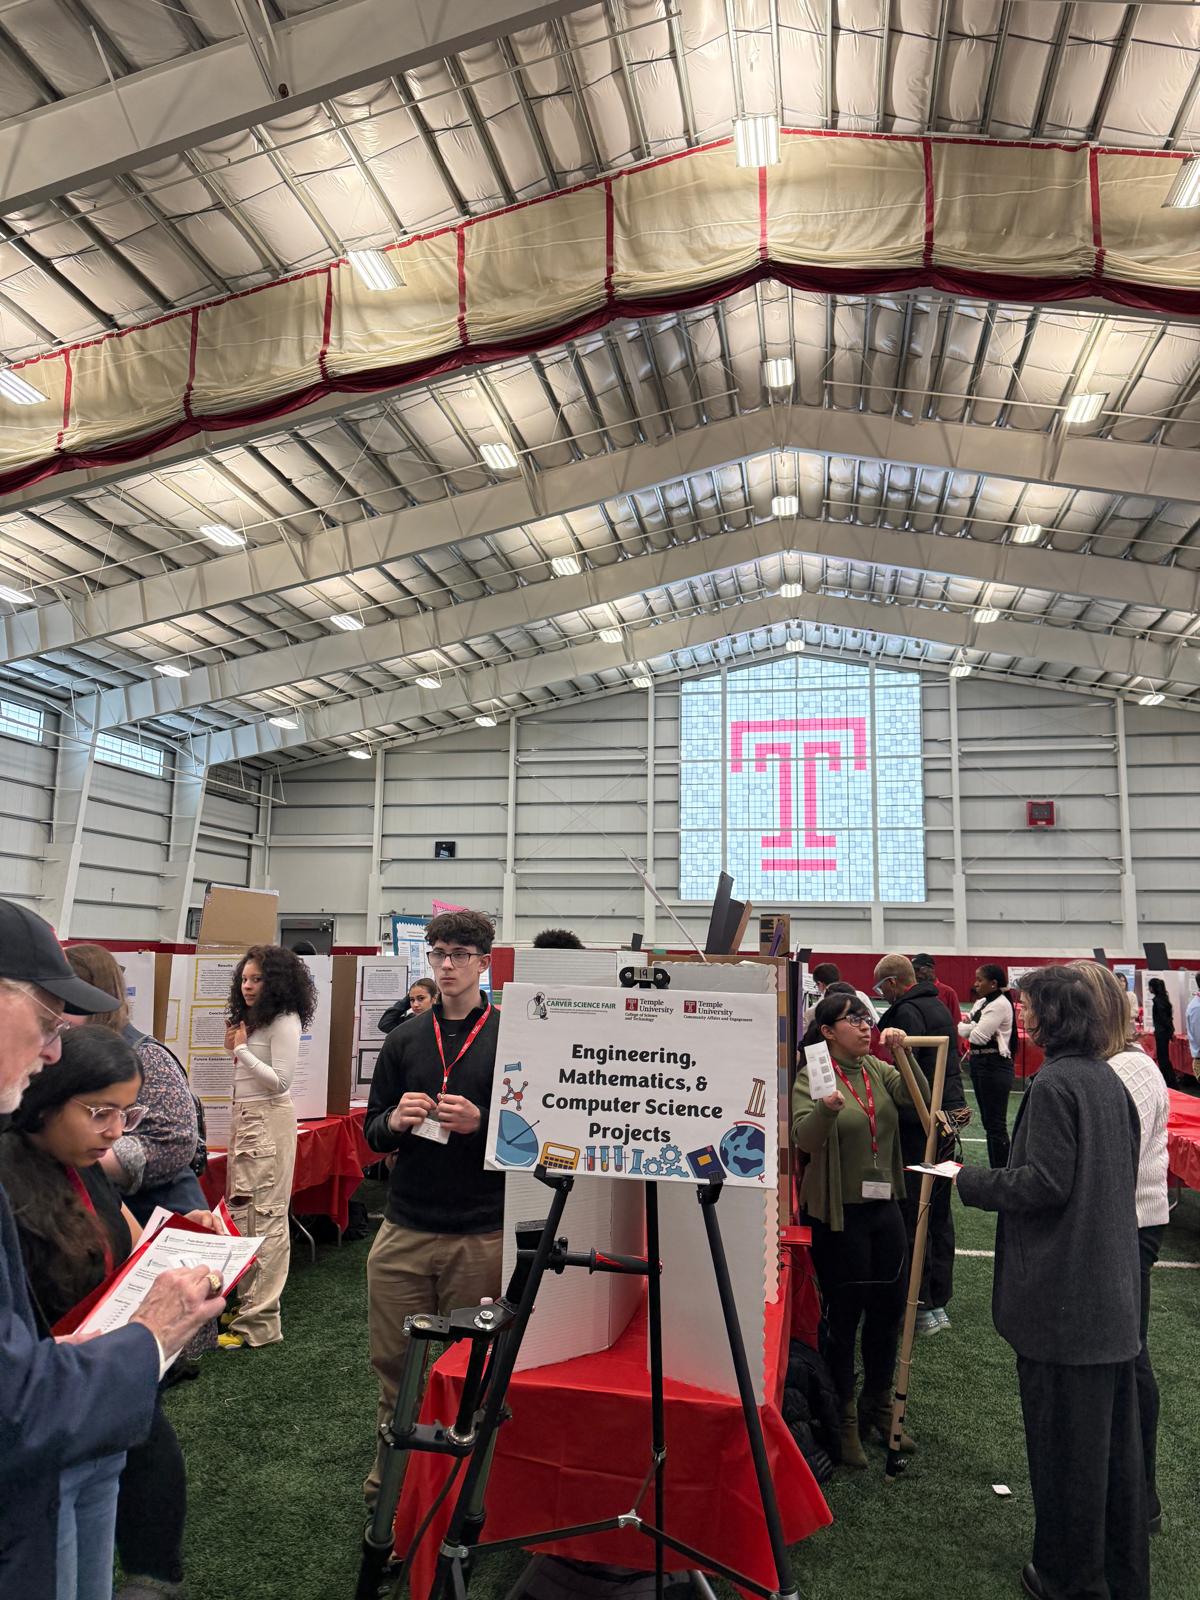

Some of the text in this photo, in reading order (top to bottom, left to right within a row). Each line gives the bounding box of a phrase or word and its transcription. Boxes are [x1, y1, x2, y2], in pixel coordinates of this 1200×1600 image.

[640, 969, 648, 979] 19
[546, 1000, 572, 1008] CARVER
[573, 1001, 600, 1009] SCIENCE
[640, 998, 664, 1007] Temple
[698, 1000, 723, 1009] Temple
[640, 1005, 674, 1015] University
[698, 1007, 733, 1017] University
[571, 1044, 697, 1069] Engineering,
[559, 1068, 708, 1092] Mathematics, &
[542, 1093, 723, 1118] Computer Science
[588, 1122, 671, 1145] Projects
